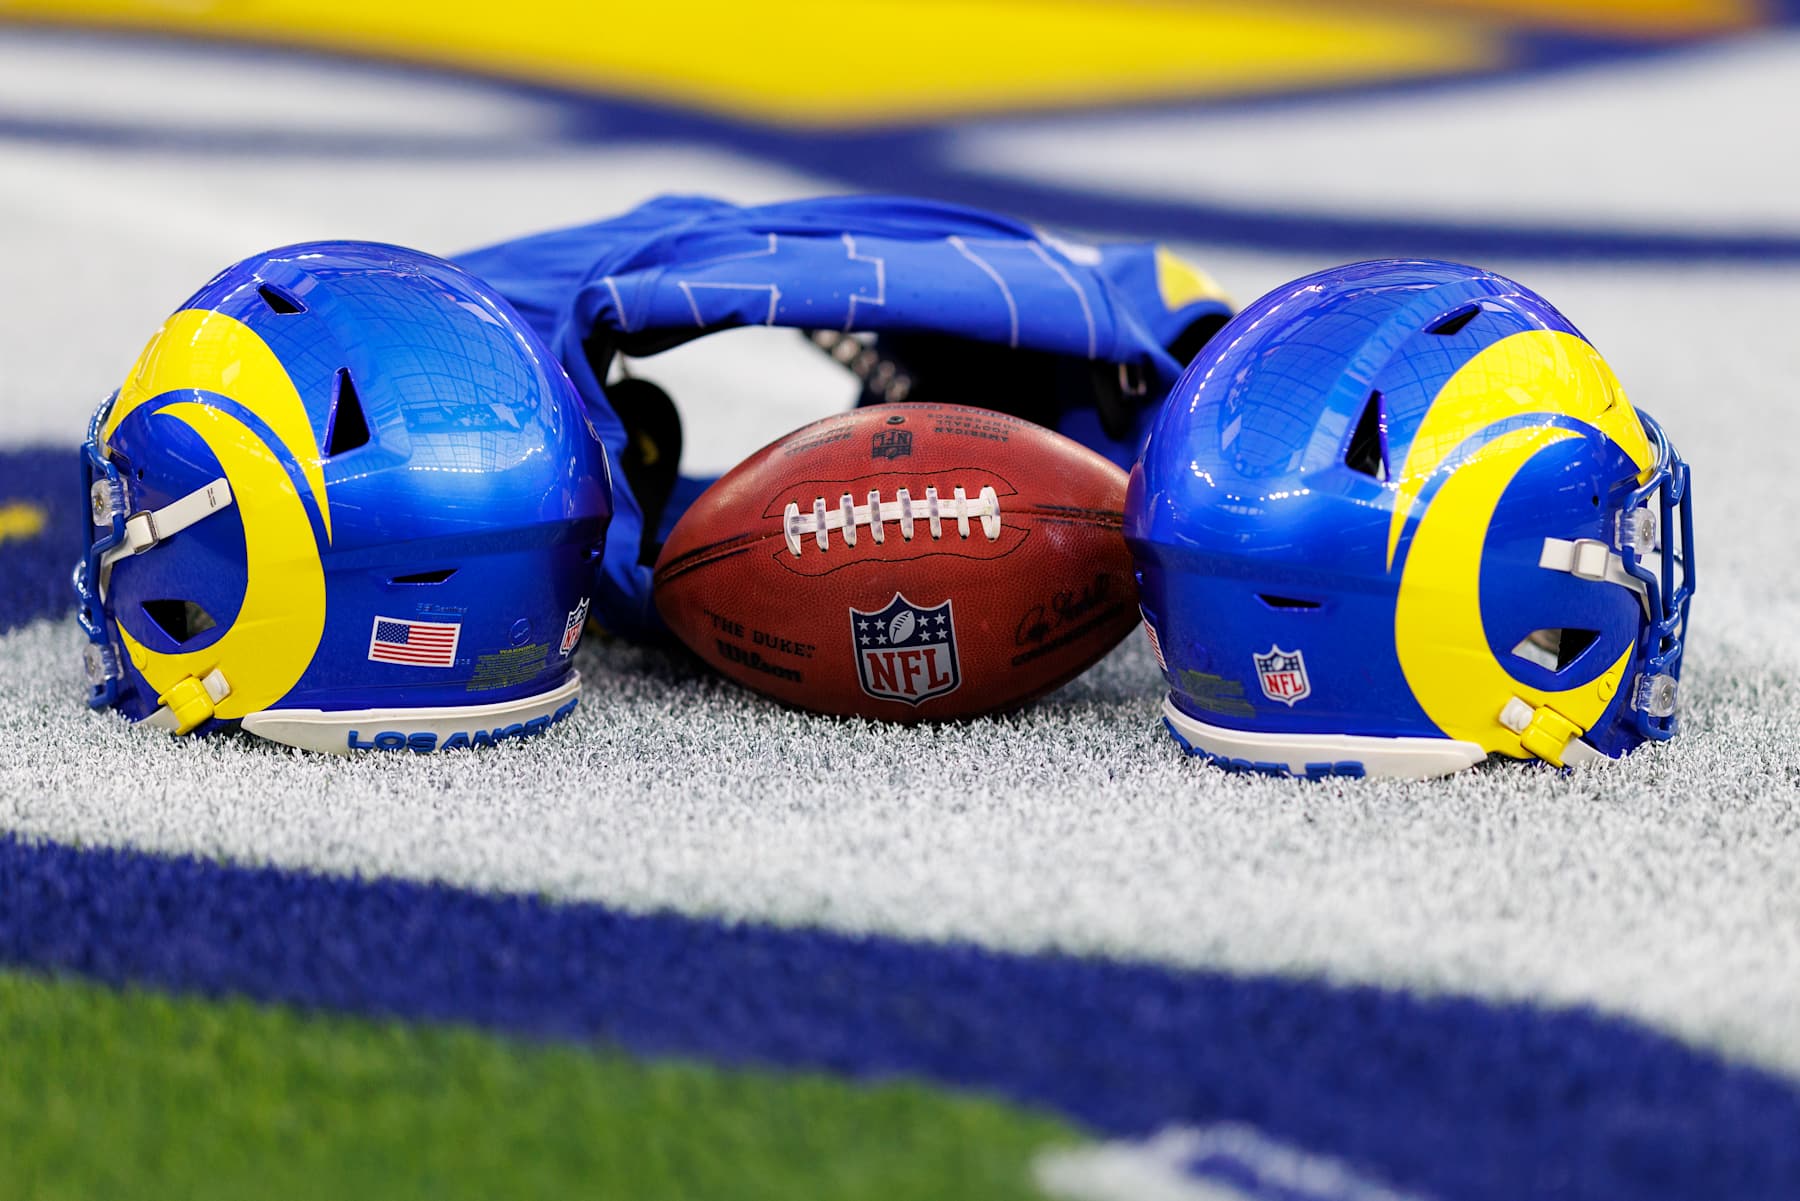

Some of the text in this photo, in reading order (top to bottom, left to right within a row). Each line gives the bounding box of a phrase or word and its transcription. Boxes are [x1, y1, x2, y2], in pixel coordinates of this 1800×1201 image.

[874, 431, 909, 447] NFL
[934, 427, 1009, 443] AMERICAN
[936, 420, 1009, 435] FOOTBALL
[716, 638, 804, 683] Wilson
[866, 649, 950, 695] NFL
[1266, 673, 1303, 696] NFL
[347, 730, 438, 753] LOS
